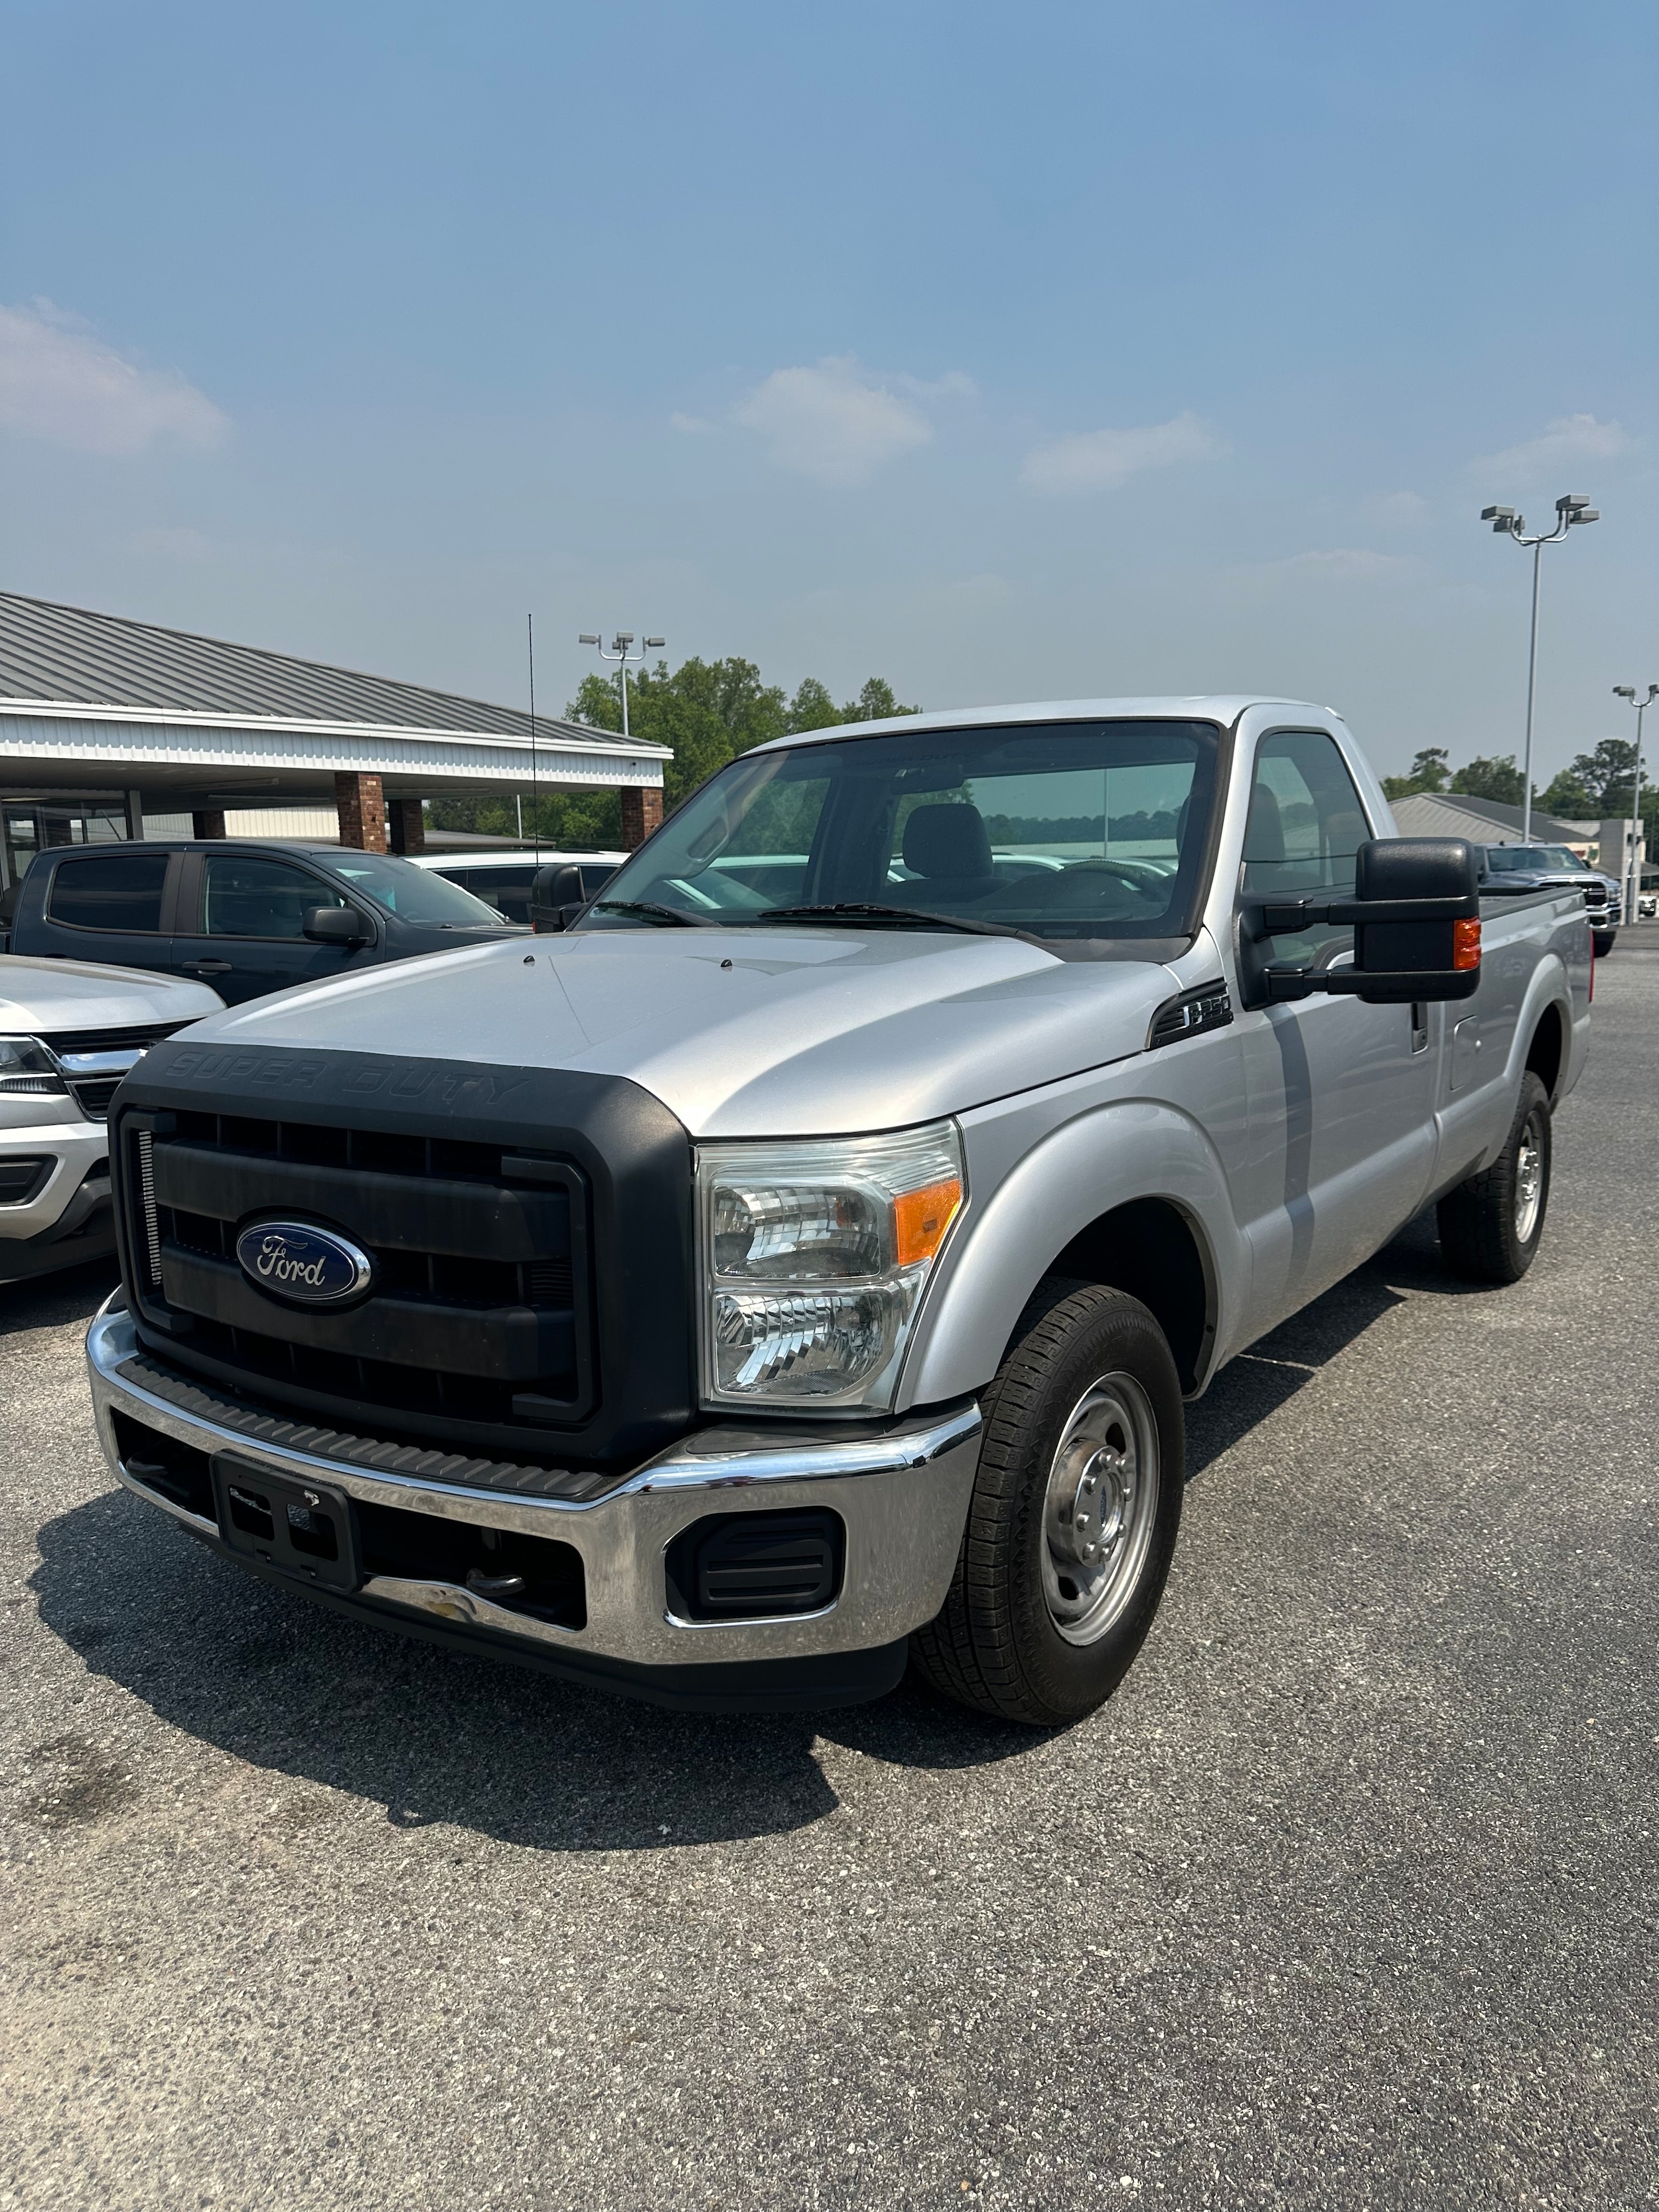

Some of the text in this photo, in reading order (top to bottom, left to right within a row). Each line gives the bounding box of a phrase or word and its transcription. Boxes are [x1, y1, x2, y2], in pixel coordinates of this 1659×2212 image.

[165, 1051, 532, 1106] SUPER DUTY
[257, 1236, 326, 1286] Ford
